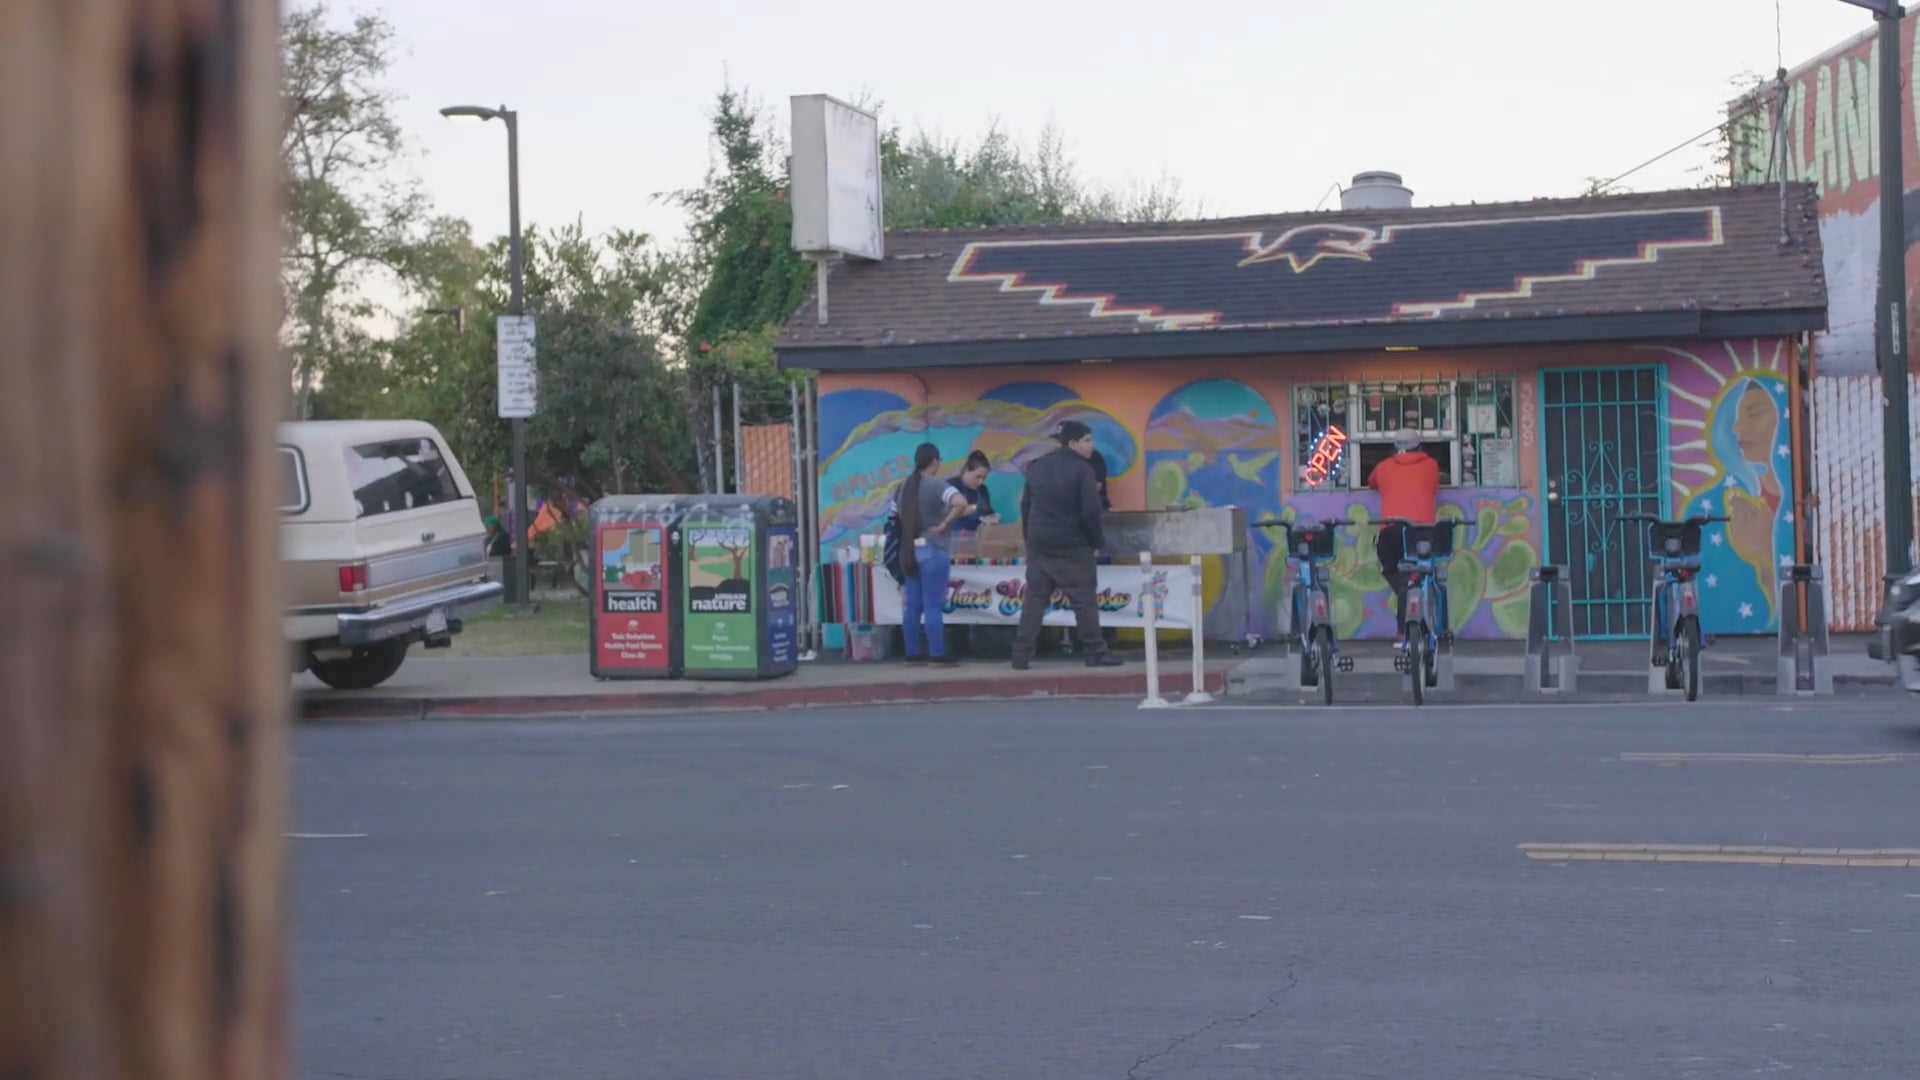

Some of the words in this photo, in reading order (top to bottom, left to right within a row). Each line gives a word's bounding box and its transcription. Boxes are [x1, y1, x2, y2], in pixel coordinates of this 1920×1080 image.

[1305, 424, 1347, 487] OPEN
[608, 596, 657, 611] health
[692, 598, 747, 611] nature
